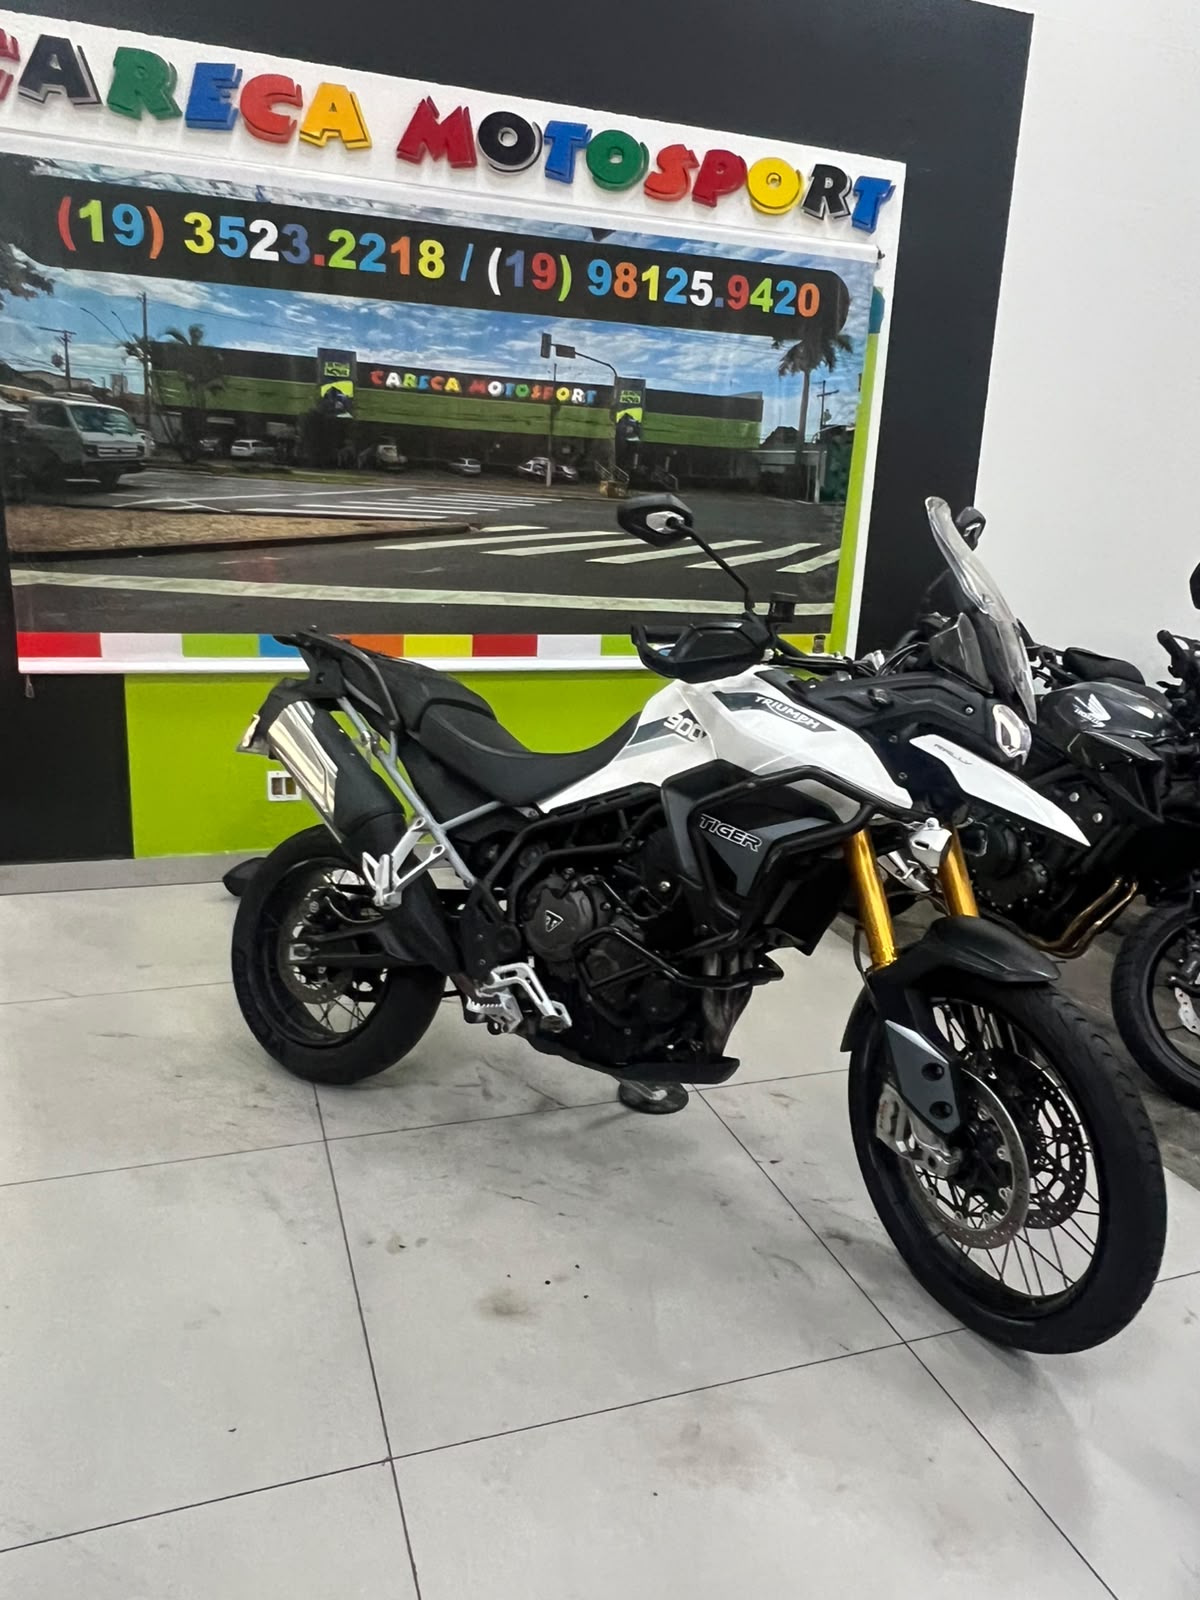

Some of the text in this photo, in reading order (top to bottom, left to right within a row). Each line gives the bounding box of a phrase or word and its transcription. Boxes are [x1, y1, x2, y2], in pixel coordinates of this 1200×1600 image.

[396, 96, 896, 232] MOTOSPORT
[58, 196, 820, 317] (19) 3523.2218 / (19) 98125.9420
[370, 370, 462, 393] CARECA
[468, 379, 597, 405] MOTOSPORT
[755, 696, 822, 729] TRIUMPH
[699, 814, 763, 852] TIGER
